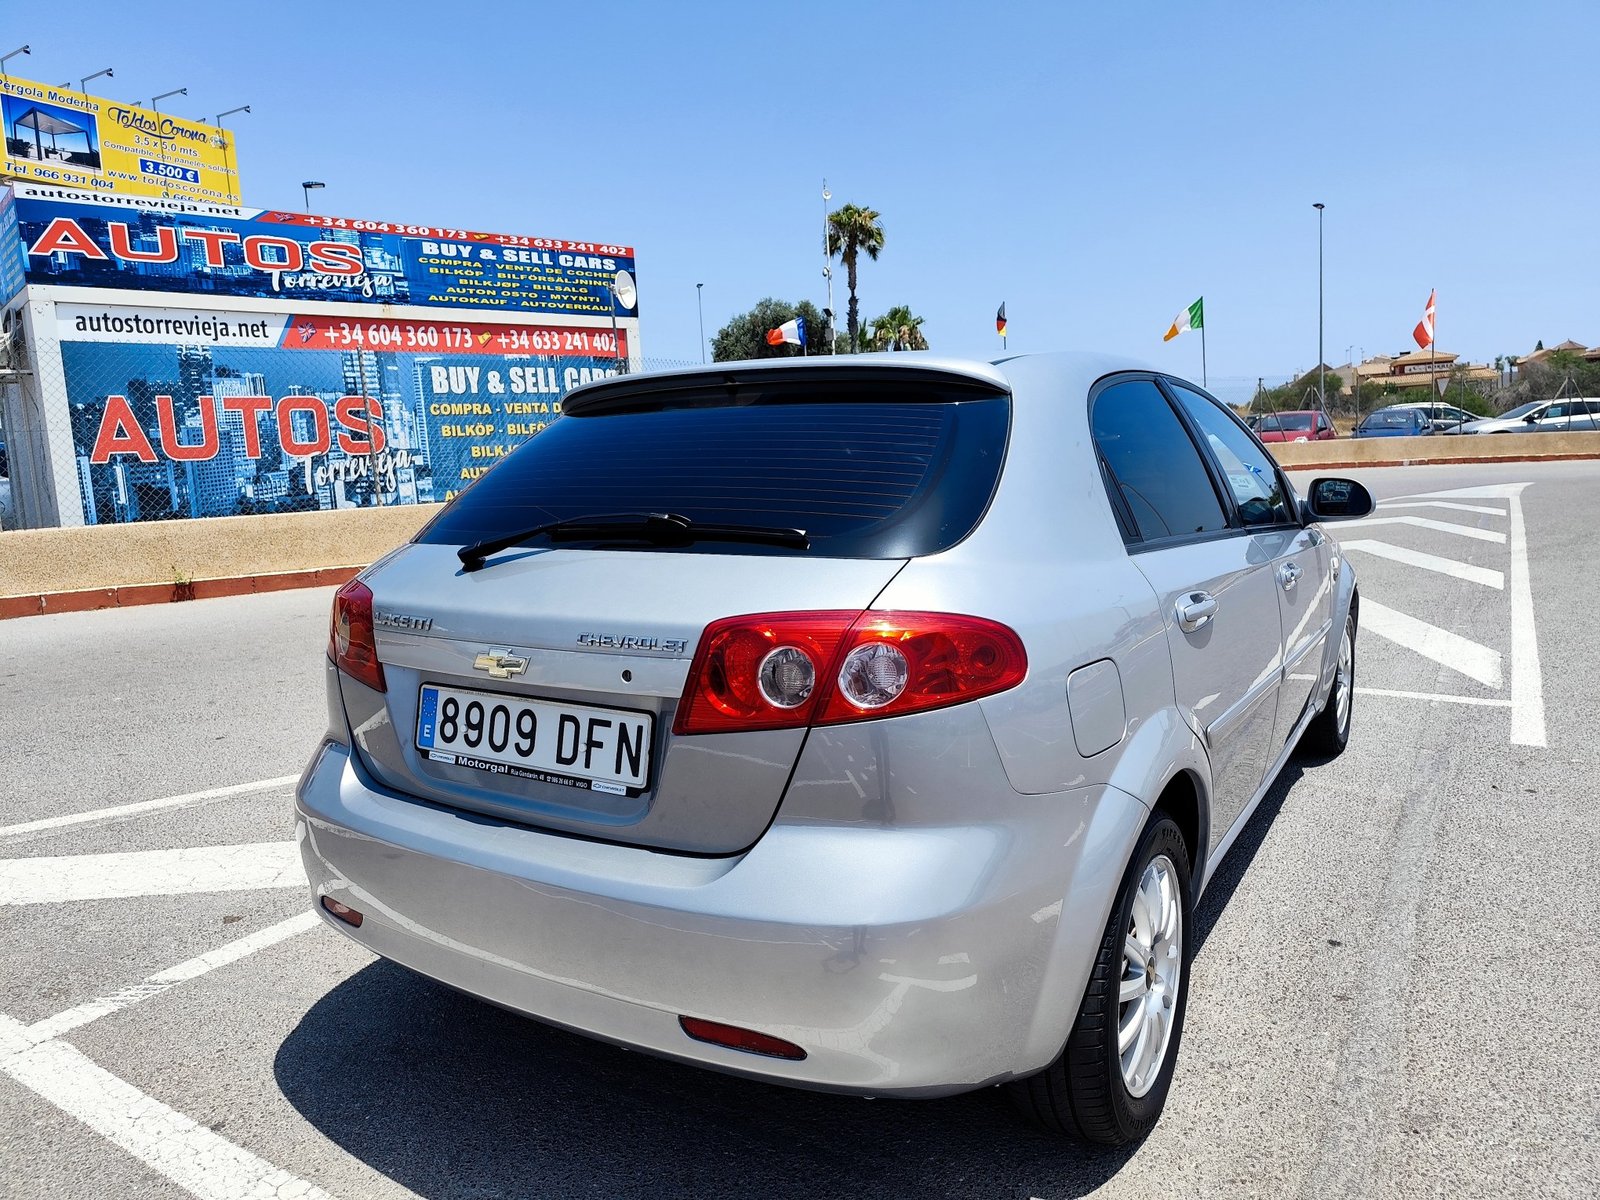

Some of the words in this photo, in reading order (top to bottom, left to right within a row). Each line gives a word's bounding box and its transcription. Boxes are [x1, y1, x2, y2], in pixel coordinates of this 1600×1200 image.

[48, 91, 99, 111] Moderna
[107, 106, 157, 133] Toldos
[160, 118, 208, 144] Corona
[103, 140, 154, 157] Compatible
[156, 153, 172, 161] con
[174, 157, 206, 169] paneles
[208, 163, 237, 175] solares
[5, 162, 29, 174] Tel.
[34, 168, 59, 179] 966
[63, 173, 86, 184] 931
[90, 178, 114, 189] 004
[145, 161, 183, 178] 3.500
[186, 170, 195, 181] €
[107, 170, 239, 201] www.toldoscorona.es
[25, 188, 242, 216] autostorrevieja.net
[304, 217, 347, 228] +34
[353, 220, 389, 232] 604
[395, 224, 430, 236] 360
[436, 228, 468, 240] 173
[28, 217, 365, 276] AUTOS
[422, 241, 472, 258] BUY
[480, 249, 497, 260] &
[503, 249, 554, 265] SELL
[559, 255, 616, 271] CARS
[495, 236, 530, 245] +34
[534, 239, 563, 249] 633
[567, 242, 594, 252] 241
[599, 245, 627, 255] 402
[418, 257, 482, 268] COMPRA
[495, 263, 541, 273] VENTA
[567, 269, 618, 279] COCHES
[429, 267, 484, 277] BILKÖP
[262, 268, 392, 298] Torrevieja
[446, 287, 497, 296] AUTON
[501, 290, 538, 299] OSTO
[550, 292, 600, 303] MYYNTI
[459, 279, 521, 288] BILKJØP
[533, 284, 588, 293] BILSALG
[428, 295, 508, 305] AUTOKAUF
[75, 312, 270, 342] autostorrevieja.net
[324, 323, 364, 345] +34
[368, 324, 402, 346] 604
[406, 325, 439, 347] 360
[442, 327, 473, 348] 173
[496, 329, 530, 350] +34
[533, 330, 561, 350] 633
[563, 331, 589, 350] 241
[592, 333, 617, 352] 402
[430, 366, 480, 394] BUY
[487, 371, 505, 394] &
[509, 367, 560, 394] SELL
[564, 367, 617, 392] CA
[429, 403, 492, 416] COMPRA
[504, 402, 549, 414] VENTA
[553, 402, 562, 413] D
[90, 395, 386, 464] AUTOS
[441, 422, 494, 437] BILKÖP
[301, 448, 412, 495] Torreveja
[374, 611, 434, 632] LACETTI
[576, 632, 688, 654] CHEVROLET
[423, 724, 432, 738] E
[439, 697, 538, 758] 8909
[556, 713, 643, 778] DFN
[458, 756, 509, 774] Motorgal
[576, 781, 588, 789] VIGO
